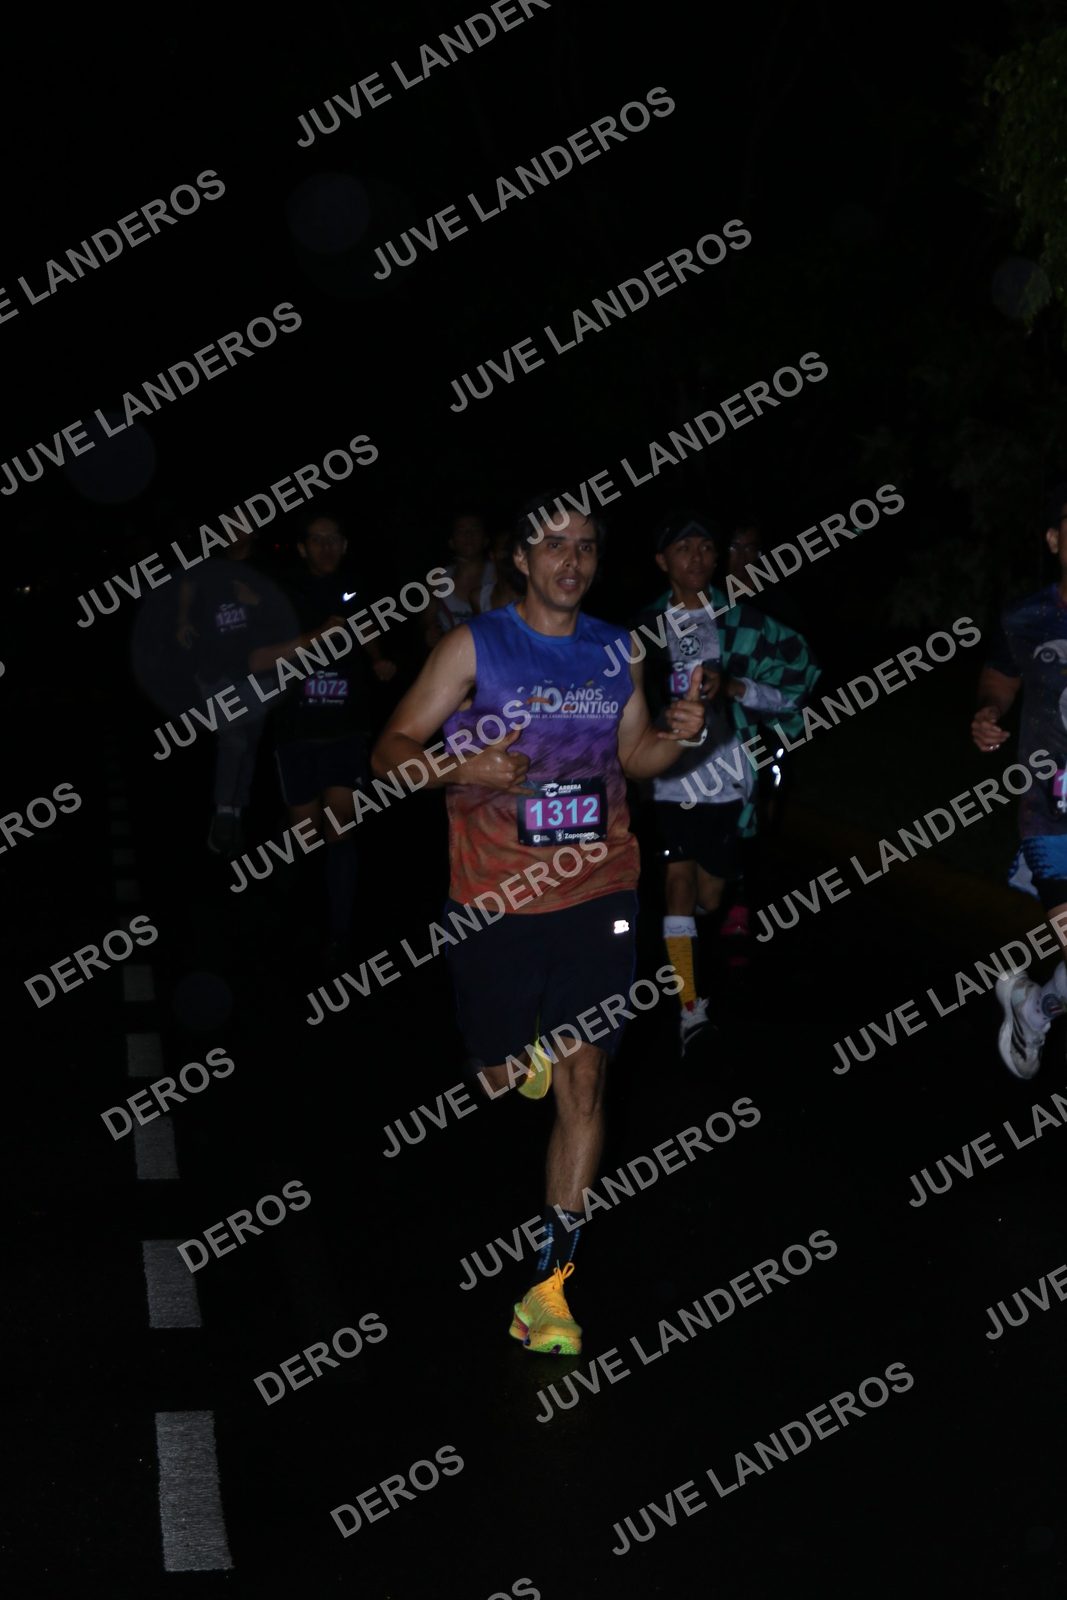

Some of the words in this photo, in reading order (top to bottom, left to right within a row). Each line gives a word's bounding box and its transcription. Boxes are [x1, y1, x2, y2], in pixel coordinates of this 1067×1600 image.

[308, 679, 348, 696] 1072
[668, 672, 690, 693] 13
[530, 685, 563, 713] 10
[561, 701, 619, 714] CONTIGO
[530, 796, 599, 827] 1312
